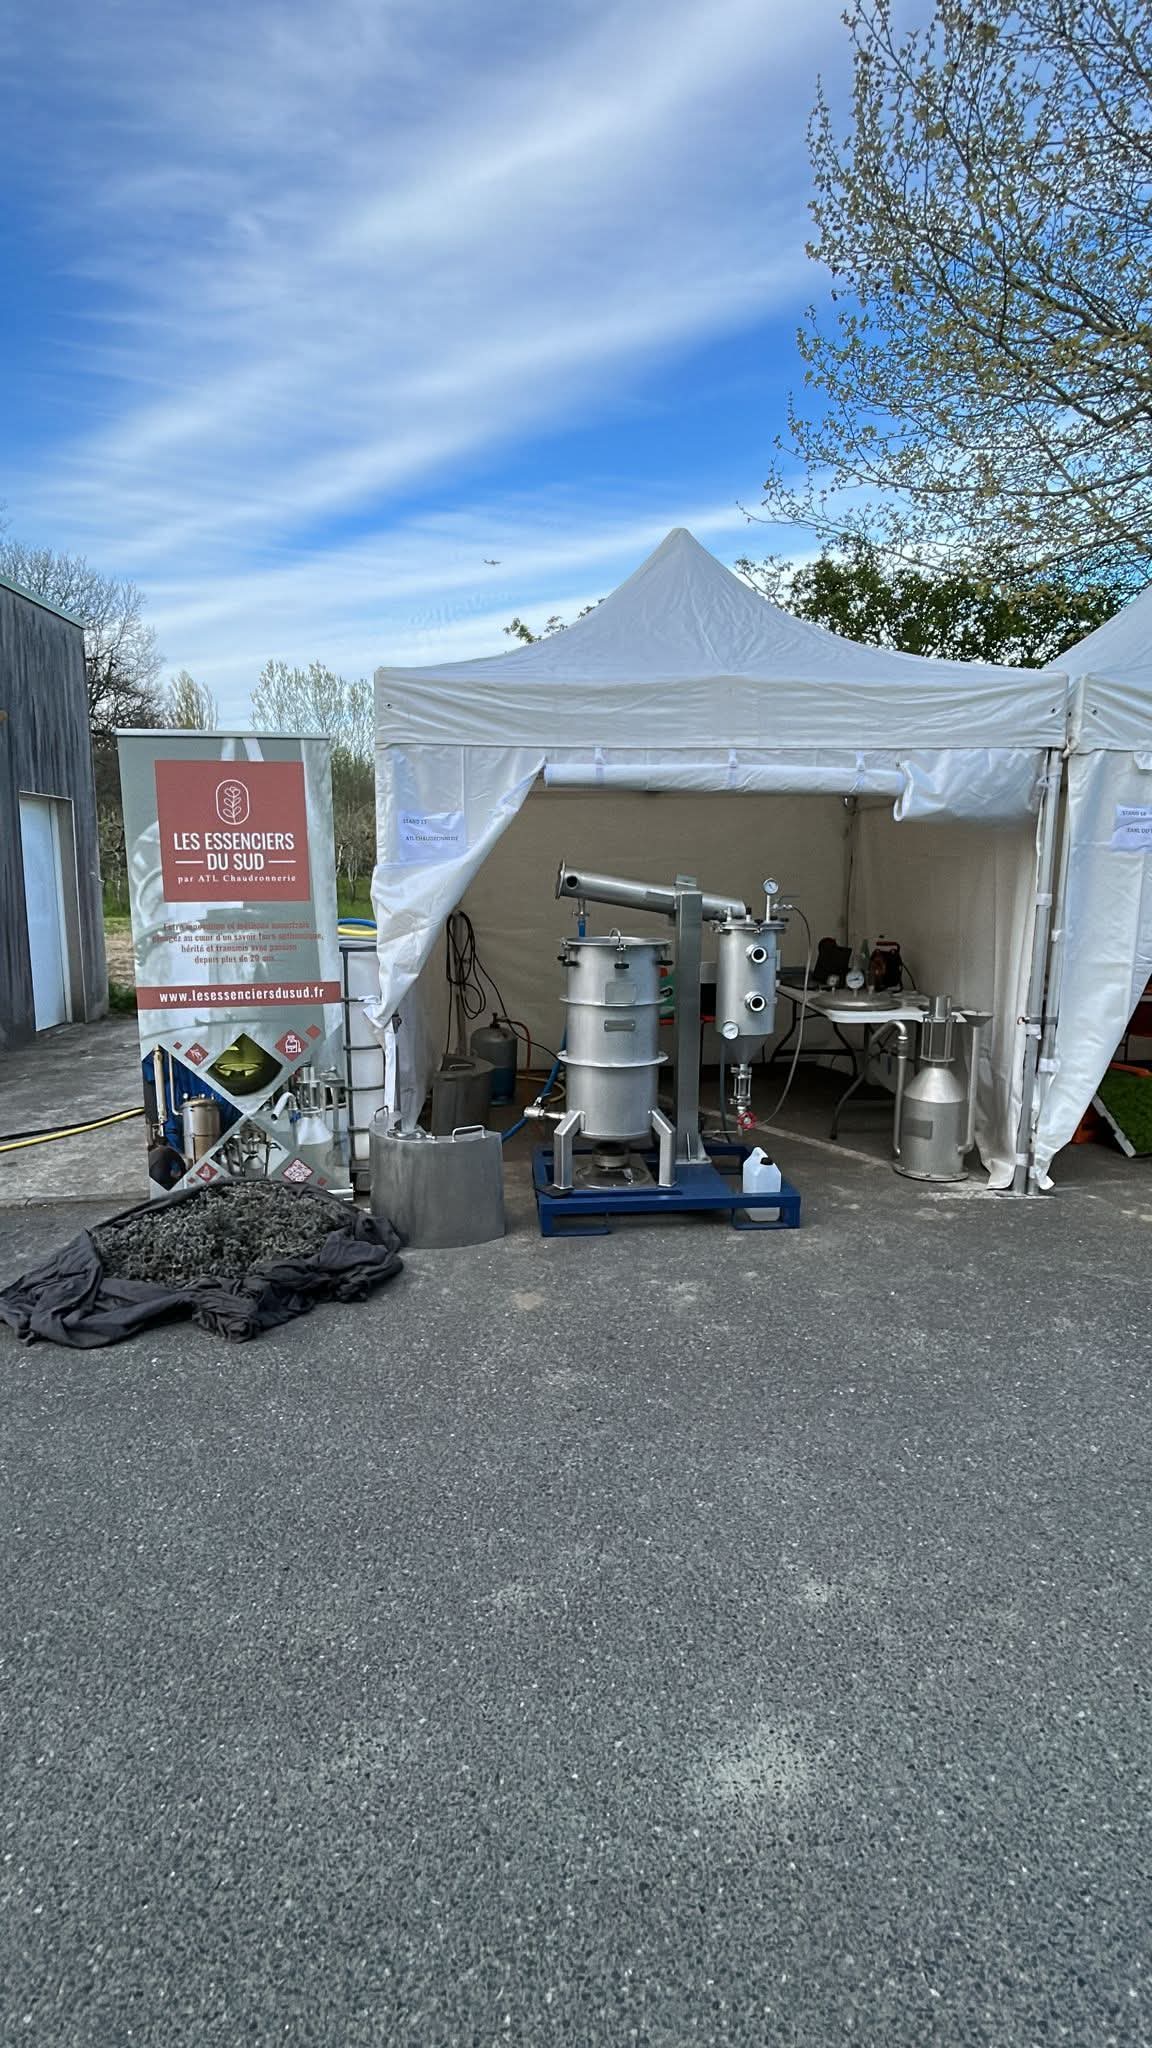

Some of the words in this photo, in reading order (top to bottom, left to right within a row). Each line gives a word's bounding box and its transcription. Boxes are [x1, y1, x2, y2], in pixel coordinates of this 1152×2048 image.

[174, 832, 200, 850] LES
[204, 832, 295, 850] ESSENCIERS
[207, 853, 228, 870] DU
[233, 852, 264, 870] SUD
[178, 876, 193, 884] par
[198, 874, 219, 882] ATL
[223, 874, 296, 882] Chaudronnerie
[182, 944, 205, 952] hérité
[194, 956, 220, 965] depuis
[159, 986, 324, 1002] www.lesessenciersdusud.fr
